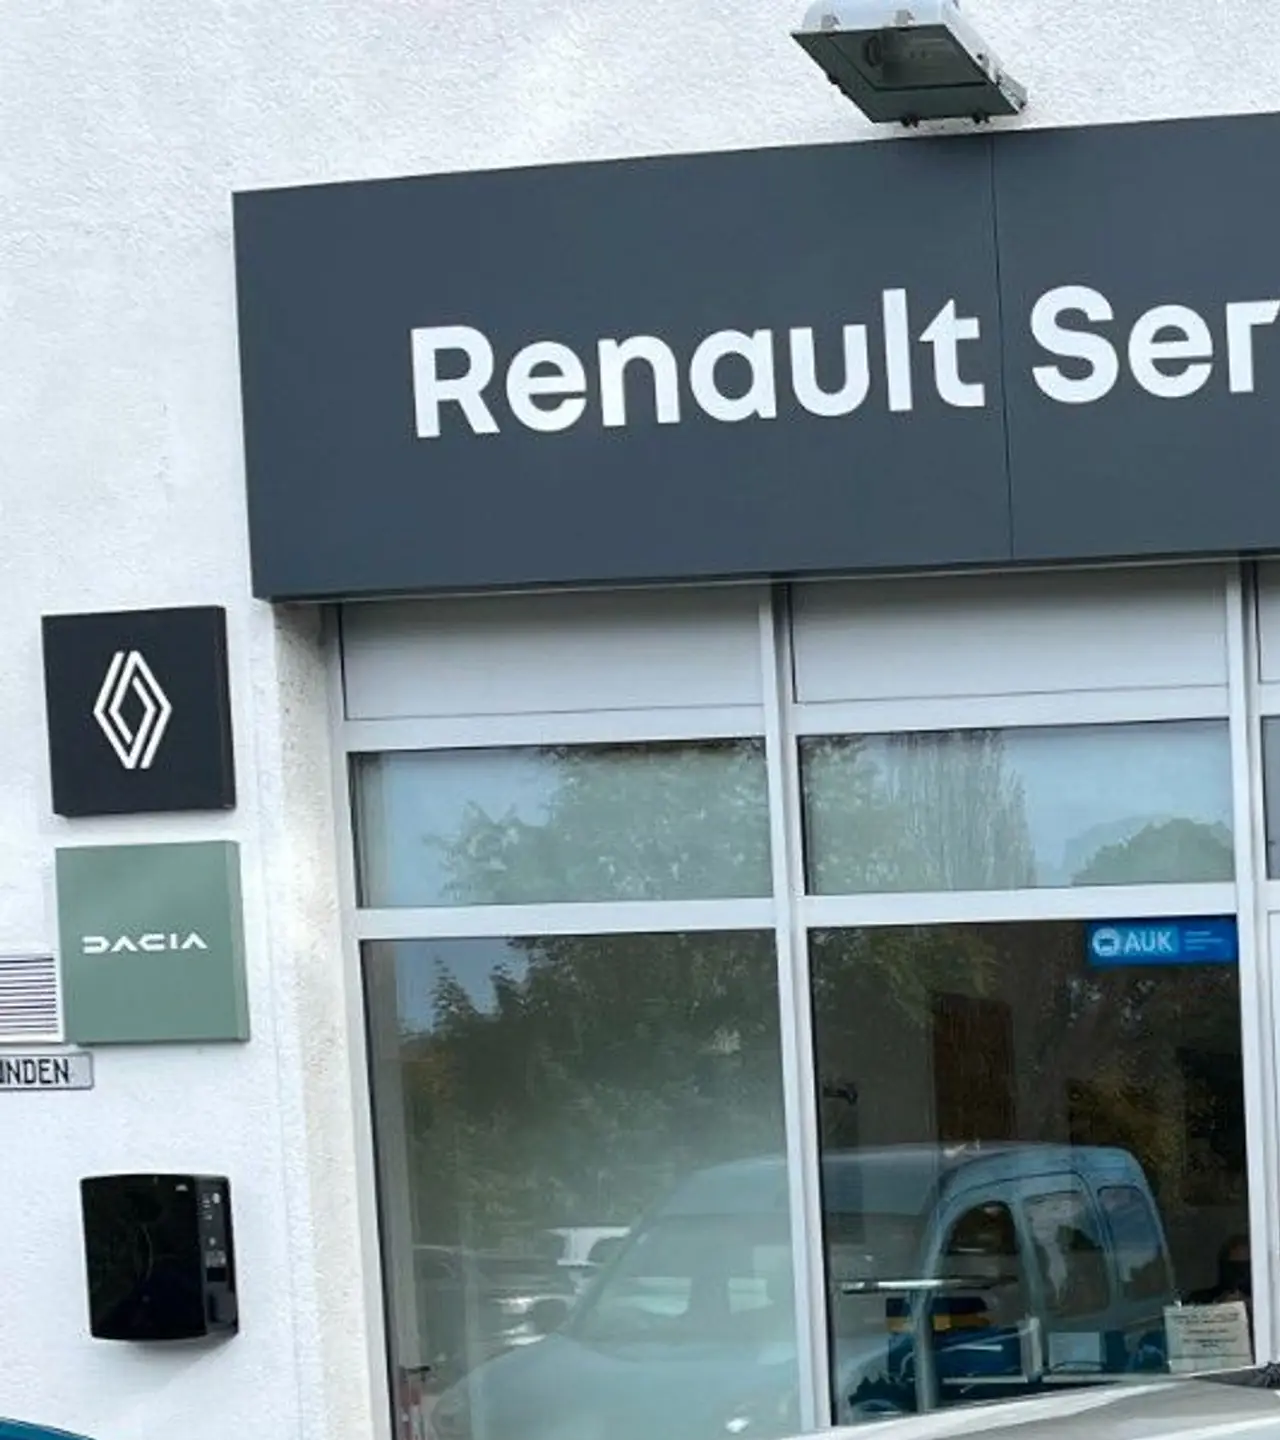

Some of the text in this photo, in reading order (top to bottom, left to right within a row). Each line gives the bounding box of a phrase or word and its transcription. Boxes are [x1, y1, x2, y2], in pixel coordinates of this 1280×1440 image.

[410, 288, 985, 438] Renault
[81, 932, 208, 954] DACIA
[1124, 930, 1173, 954] AUK
